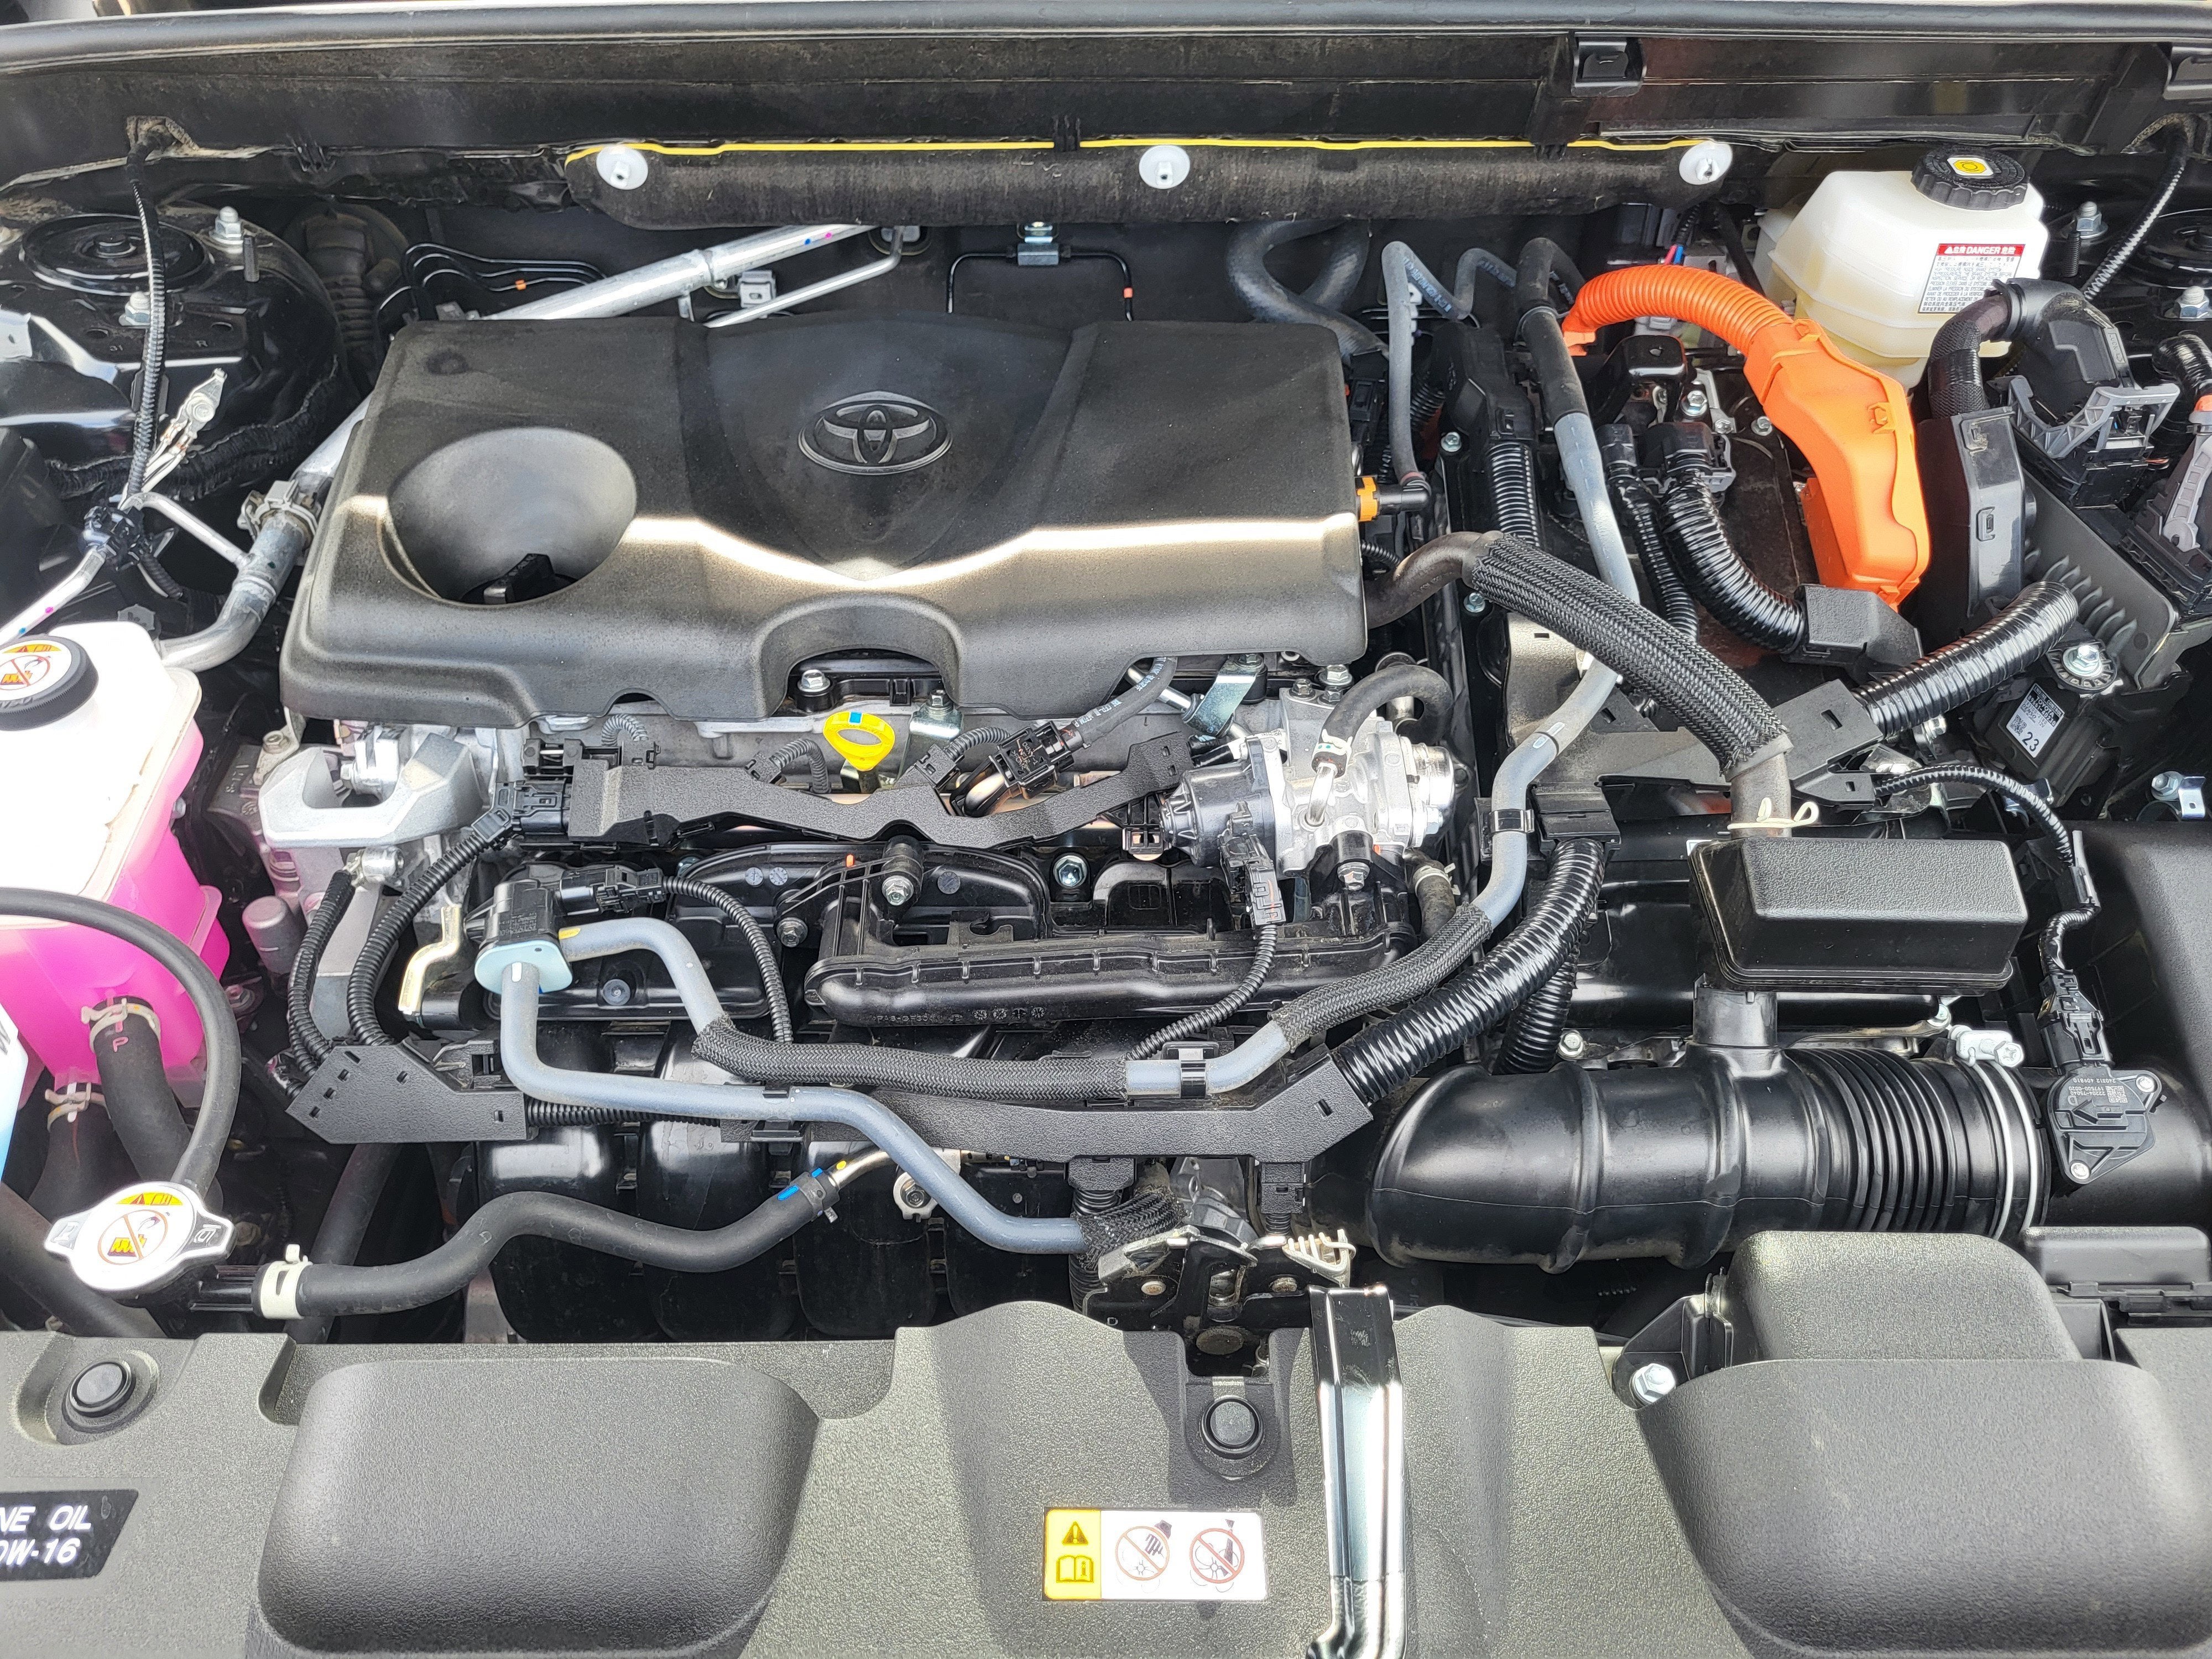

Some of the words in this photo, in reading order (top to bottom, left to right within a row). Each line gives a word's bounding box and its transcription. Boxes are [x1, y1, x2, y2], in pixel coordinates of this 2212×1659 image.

[2035, 695, 2054, 718] TOYOTA
[2022, 732, 2039, 752] 23
[113, 1036, 129, 1052] P
[49, 1505, 92, 1531] OIL
